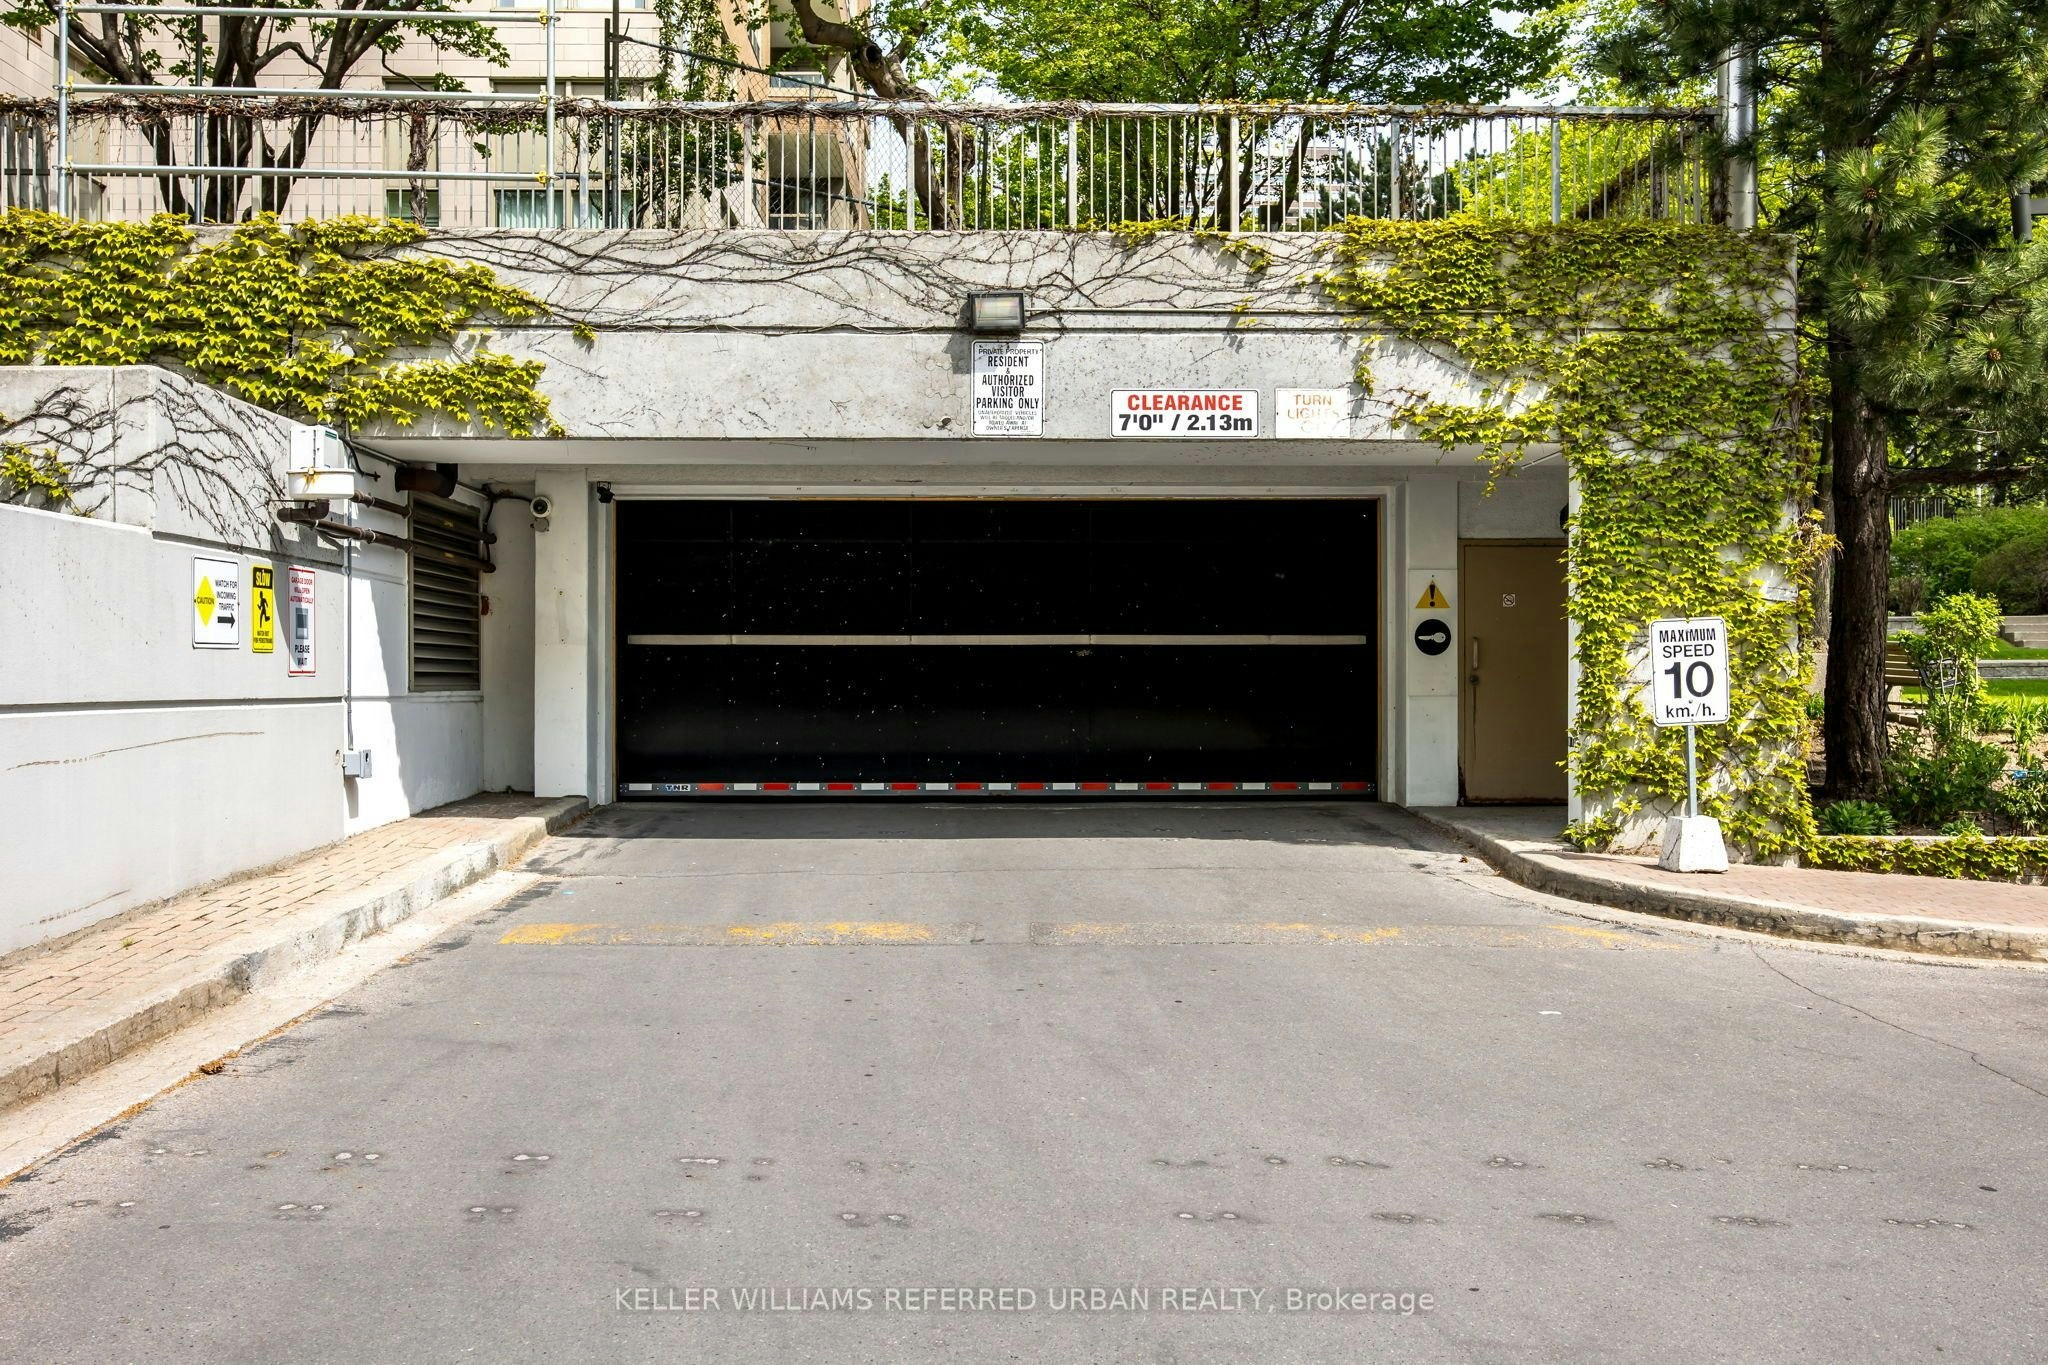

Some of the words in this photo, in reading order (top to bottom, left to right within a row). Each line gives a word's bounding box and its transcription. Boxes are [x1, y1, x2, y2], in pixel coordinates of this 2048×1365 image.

[988, 356, 1029, 367] RESIDENT
[982, 375, 1034, 386] AUTHORIZED
[992, 386, 1025, 397] VISITOR
[976, 398, 1014, 409] PARKING
[1018, 398, 1040, 409] ONLY
[1127, 394, 1243, 411] CLEARANCE
[1294, 394, 1332, 406] TURN
[1118, 413, 1163, 431] 7'0"
[1171, 413, 1181, 431] /
[1187, 413, 1253, 431] 2.13m
[255, 571, 271, 587] SLOW
[230, 581, 238, 589] FOR
[196, 596, 215, 605] CAUTION
[219, 602, 235, 611] TRAFFIC
[1659, 628, 1716, 643] MAXIMUM
[294, 644, 310, 653] PLEASE
[1662, 643, 1715, 659] SPEED
[297, 657, 308, 666] WAIT
[1664, 660, 1715, 699] 10
[1666, 702, 1716, 719] km./h.
[665, 783, 691, 791] TNR
